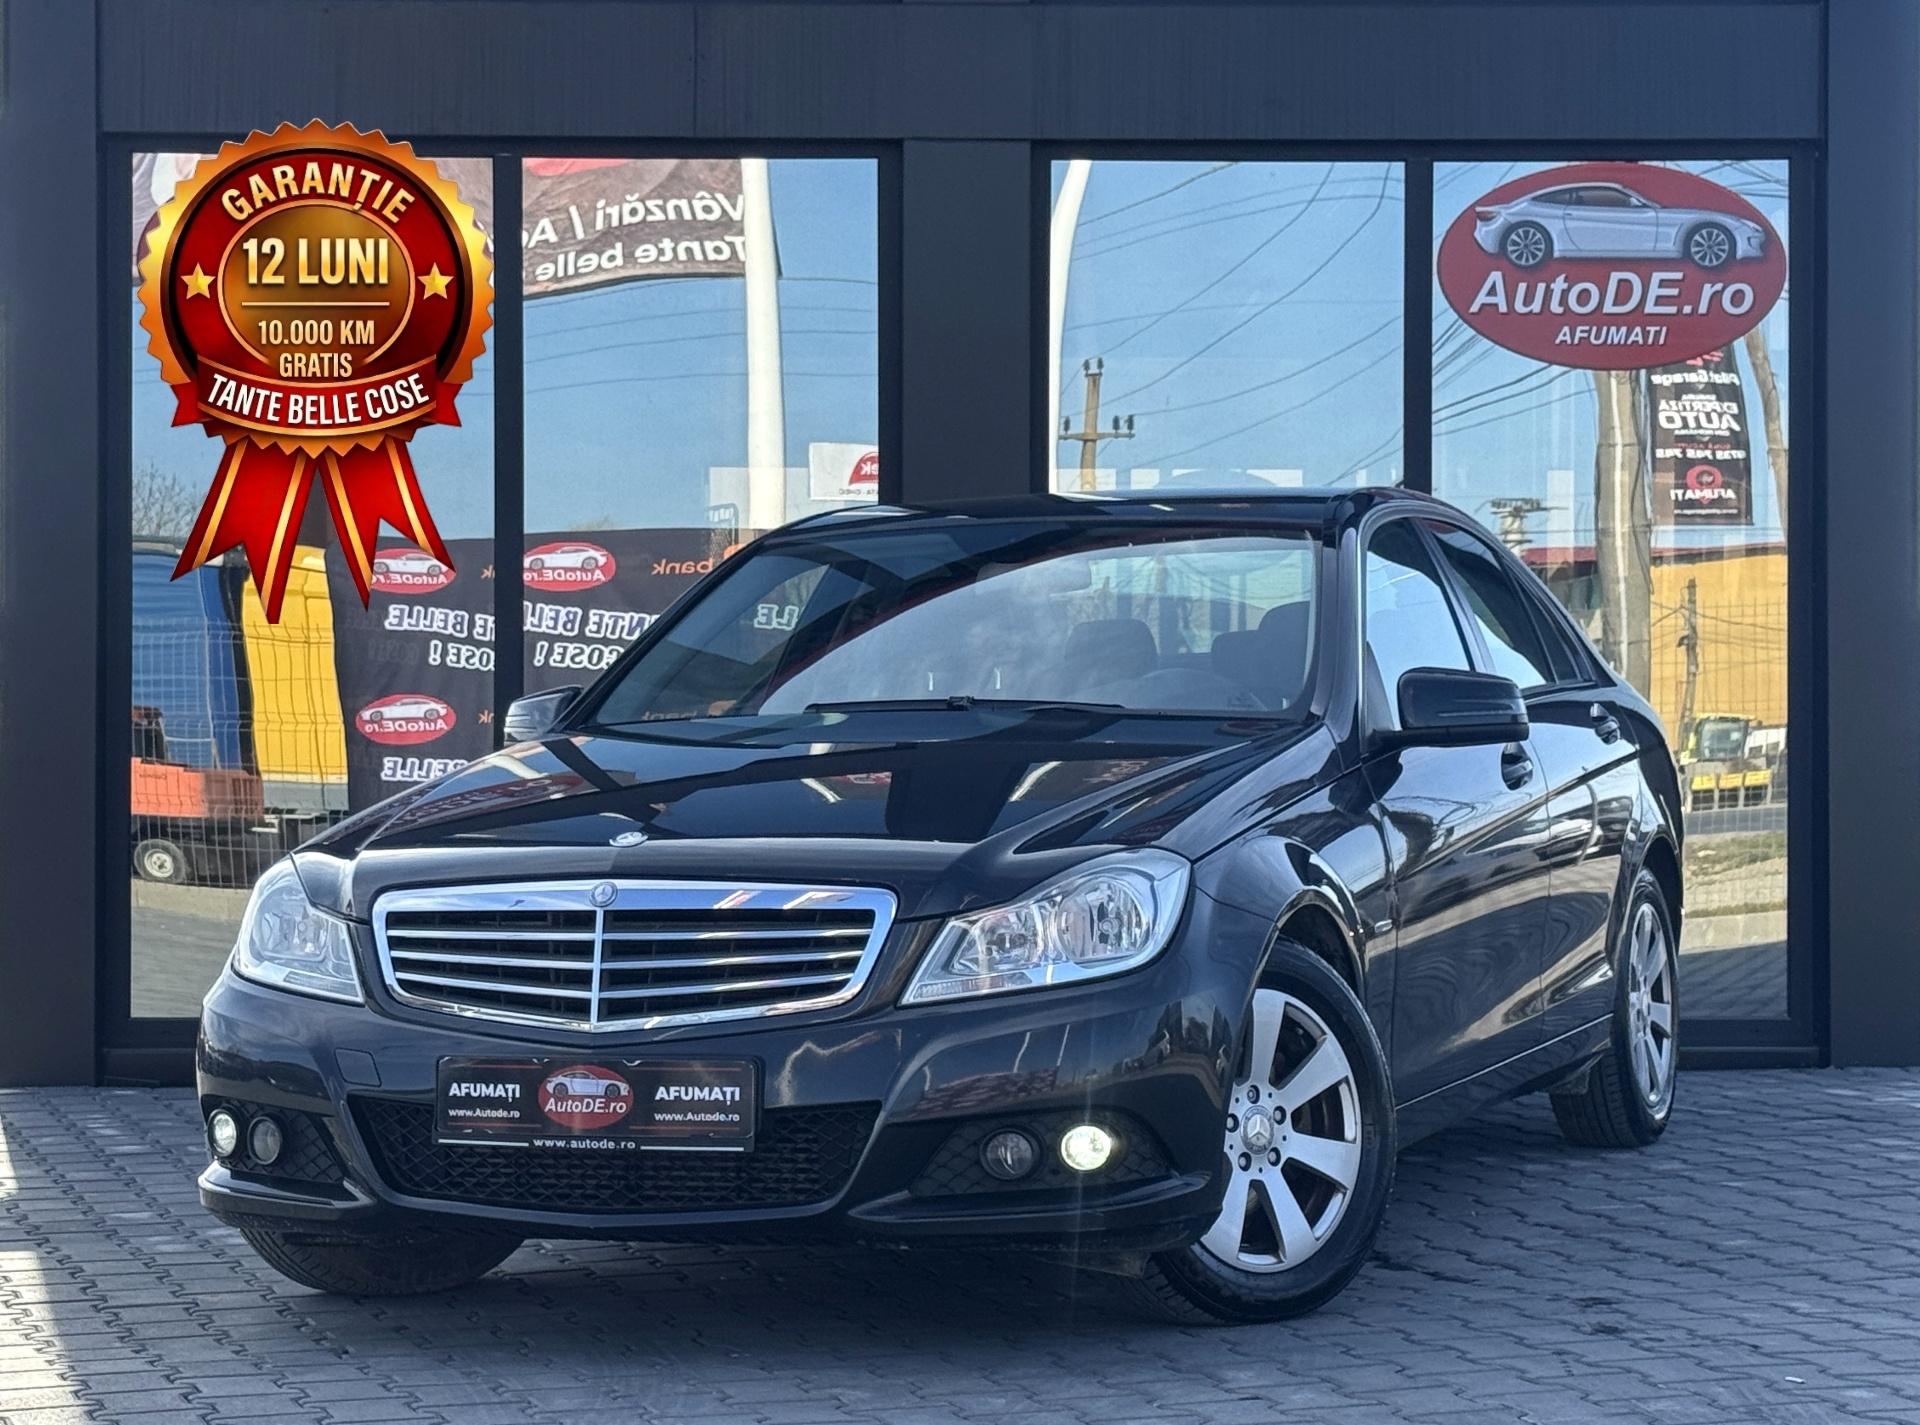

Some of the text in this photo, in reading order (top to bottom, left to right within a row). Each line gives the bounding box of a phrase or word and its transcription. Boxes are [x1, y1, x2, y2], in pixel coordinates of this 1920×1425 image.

[1469, 271, 1754, 315] AutoDE.ro
[1555, 326, 1667, 346] AFUMATI
[449, 1083, 521, 1102] AFUMAȚI
[654, 1086, 741, 1105] AFUMAȚI
[448, 1107, 521, 1119] www.Autode.ro
[544, 1097, 627, 1114] AutoDE.ro
[654, 1111, 740, 1122] www.Autode.ro
[533, 1137, 636, 1150] www.autode.ro
